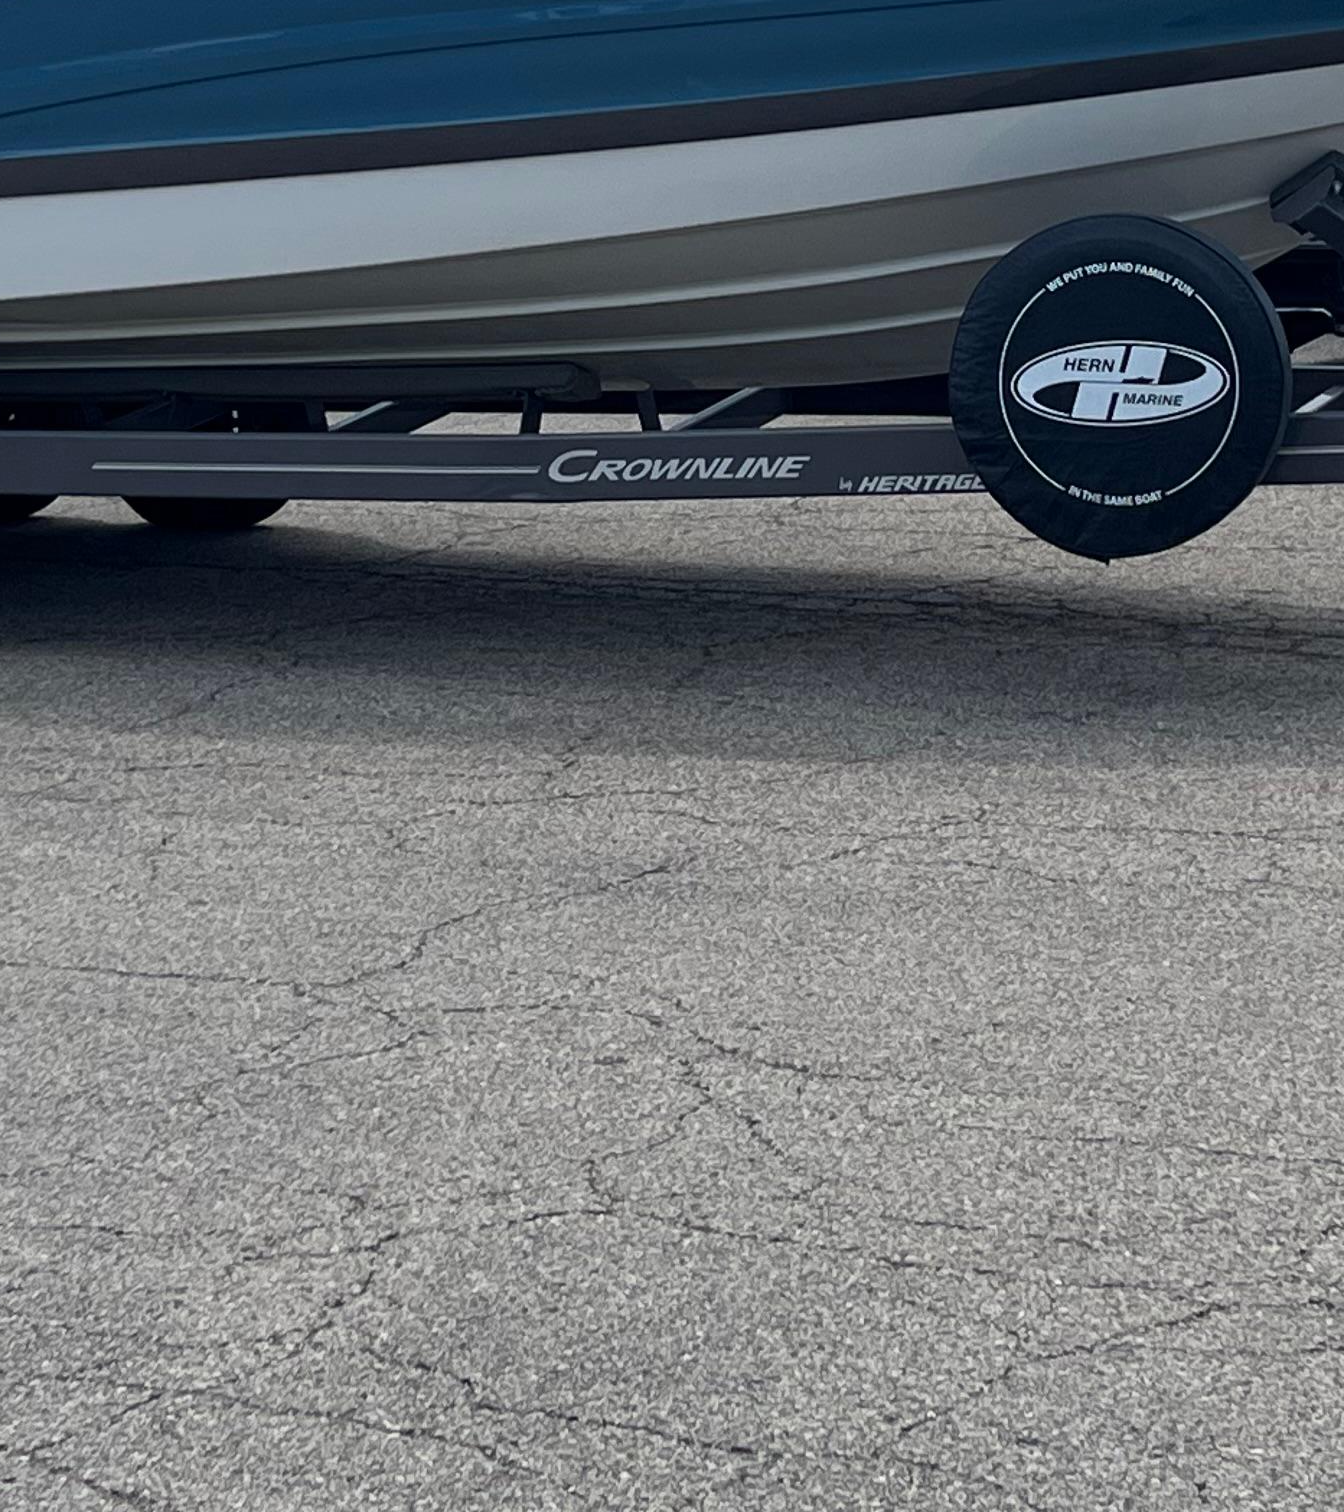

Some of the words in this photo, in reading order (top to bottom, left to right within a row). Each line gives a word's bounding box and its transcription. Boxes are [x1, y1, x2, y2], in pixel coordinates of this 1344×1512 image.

[1046, 276, 1064, 292] WE
[1063, 267, 1084, 283] PUT
[1084, 262, 1107, 275] YOU
[1109, 262, 1134, 273] AND
[1134, 264, 1173, 284] FAMILY
[1172, 277, 1195, 297] FUN
[1063, 357, 1116, 373] HERN
[1122, 392, 1184, 407] MARINE
[547, 448, 811, 483] CROWNLINE
[1068, 485, 1082, 498] IN
[1082, 489, 1102, 504] THE
[1104, 494, 1134, 506] SAME
[1135, 490, 1162, 506] BOAT
